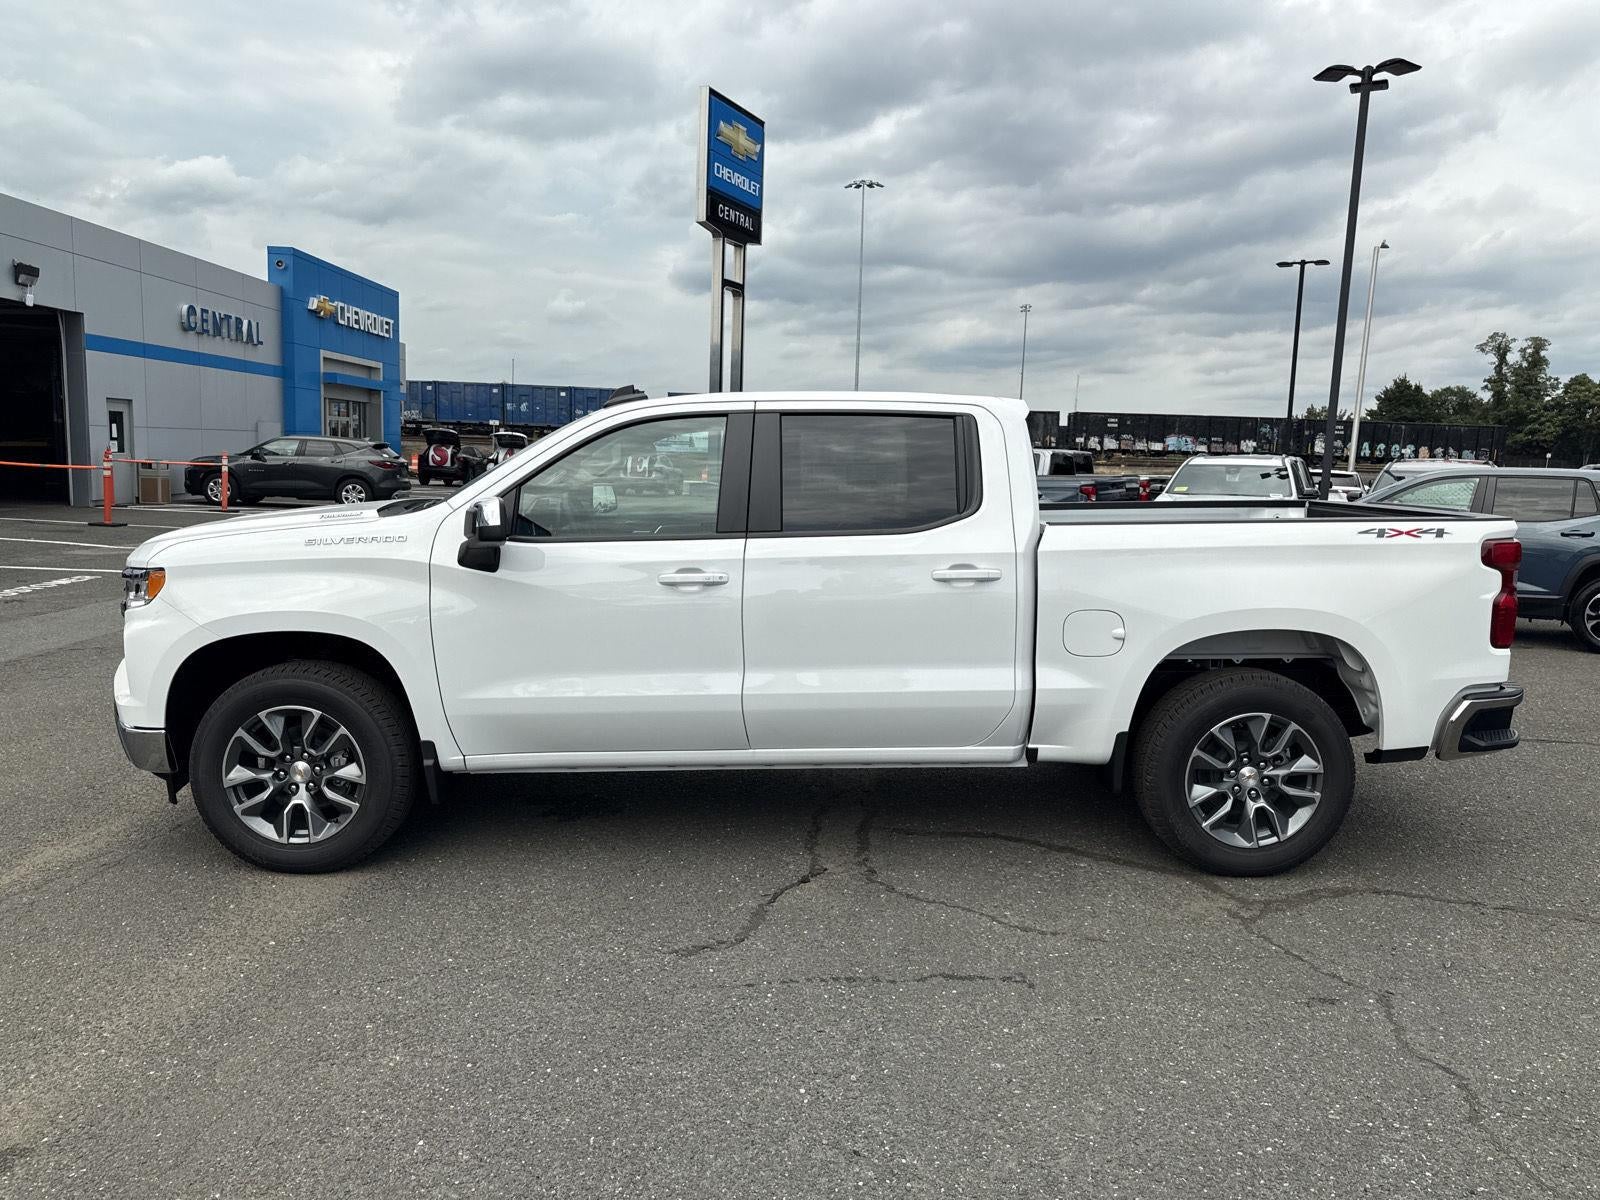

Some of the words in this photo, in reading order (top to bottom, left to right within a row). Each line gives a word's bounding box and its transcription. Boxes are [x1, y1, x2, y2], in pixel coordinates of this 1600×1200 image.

[714, 162, 760, 197] CHEVROLET
[718, 203, 754, 231] CENTRAL
[181, 304, 264, 346] CENTRAL
[337, 301, 394, 339] CHEVROLET
[304, 535, 408, 546] SILVERADO
